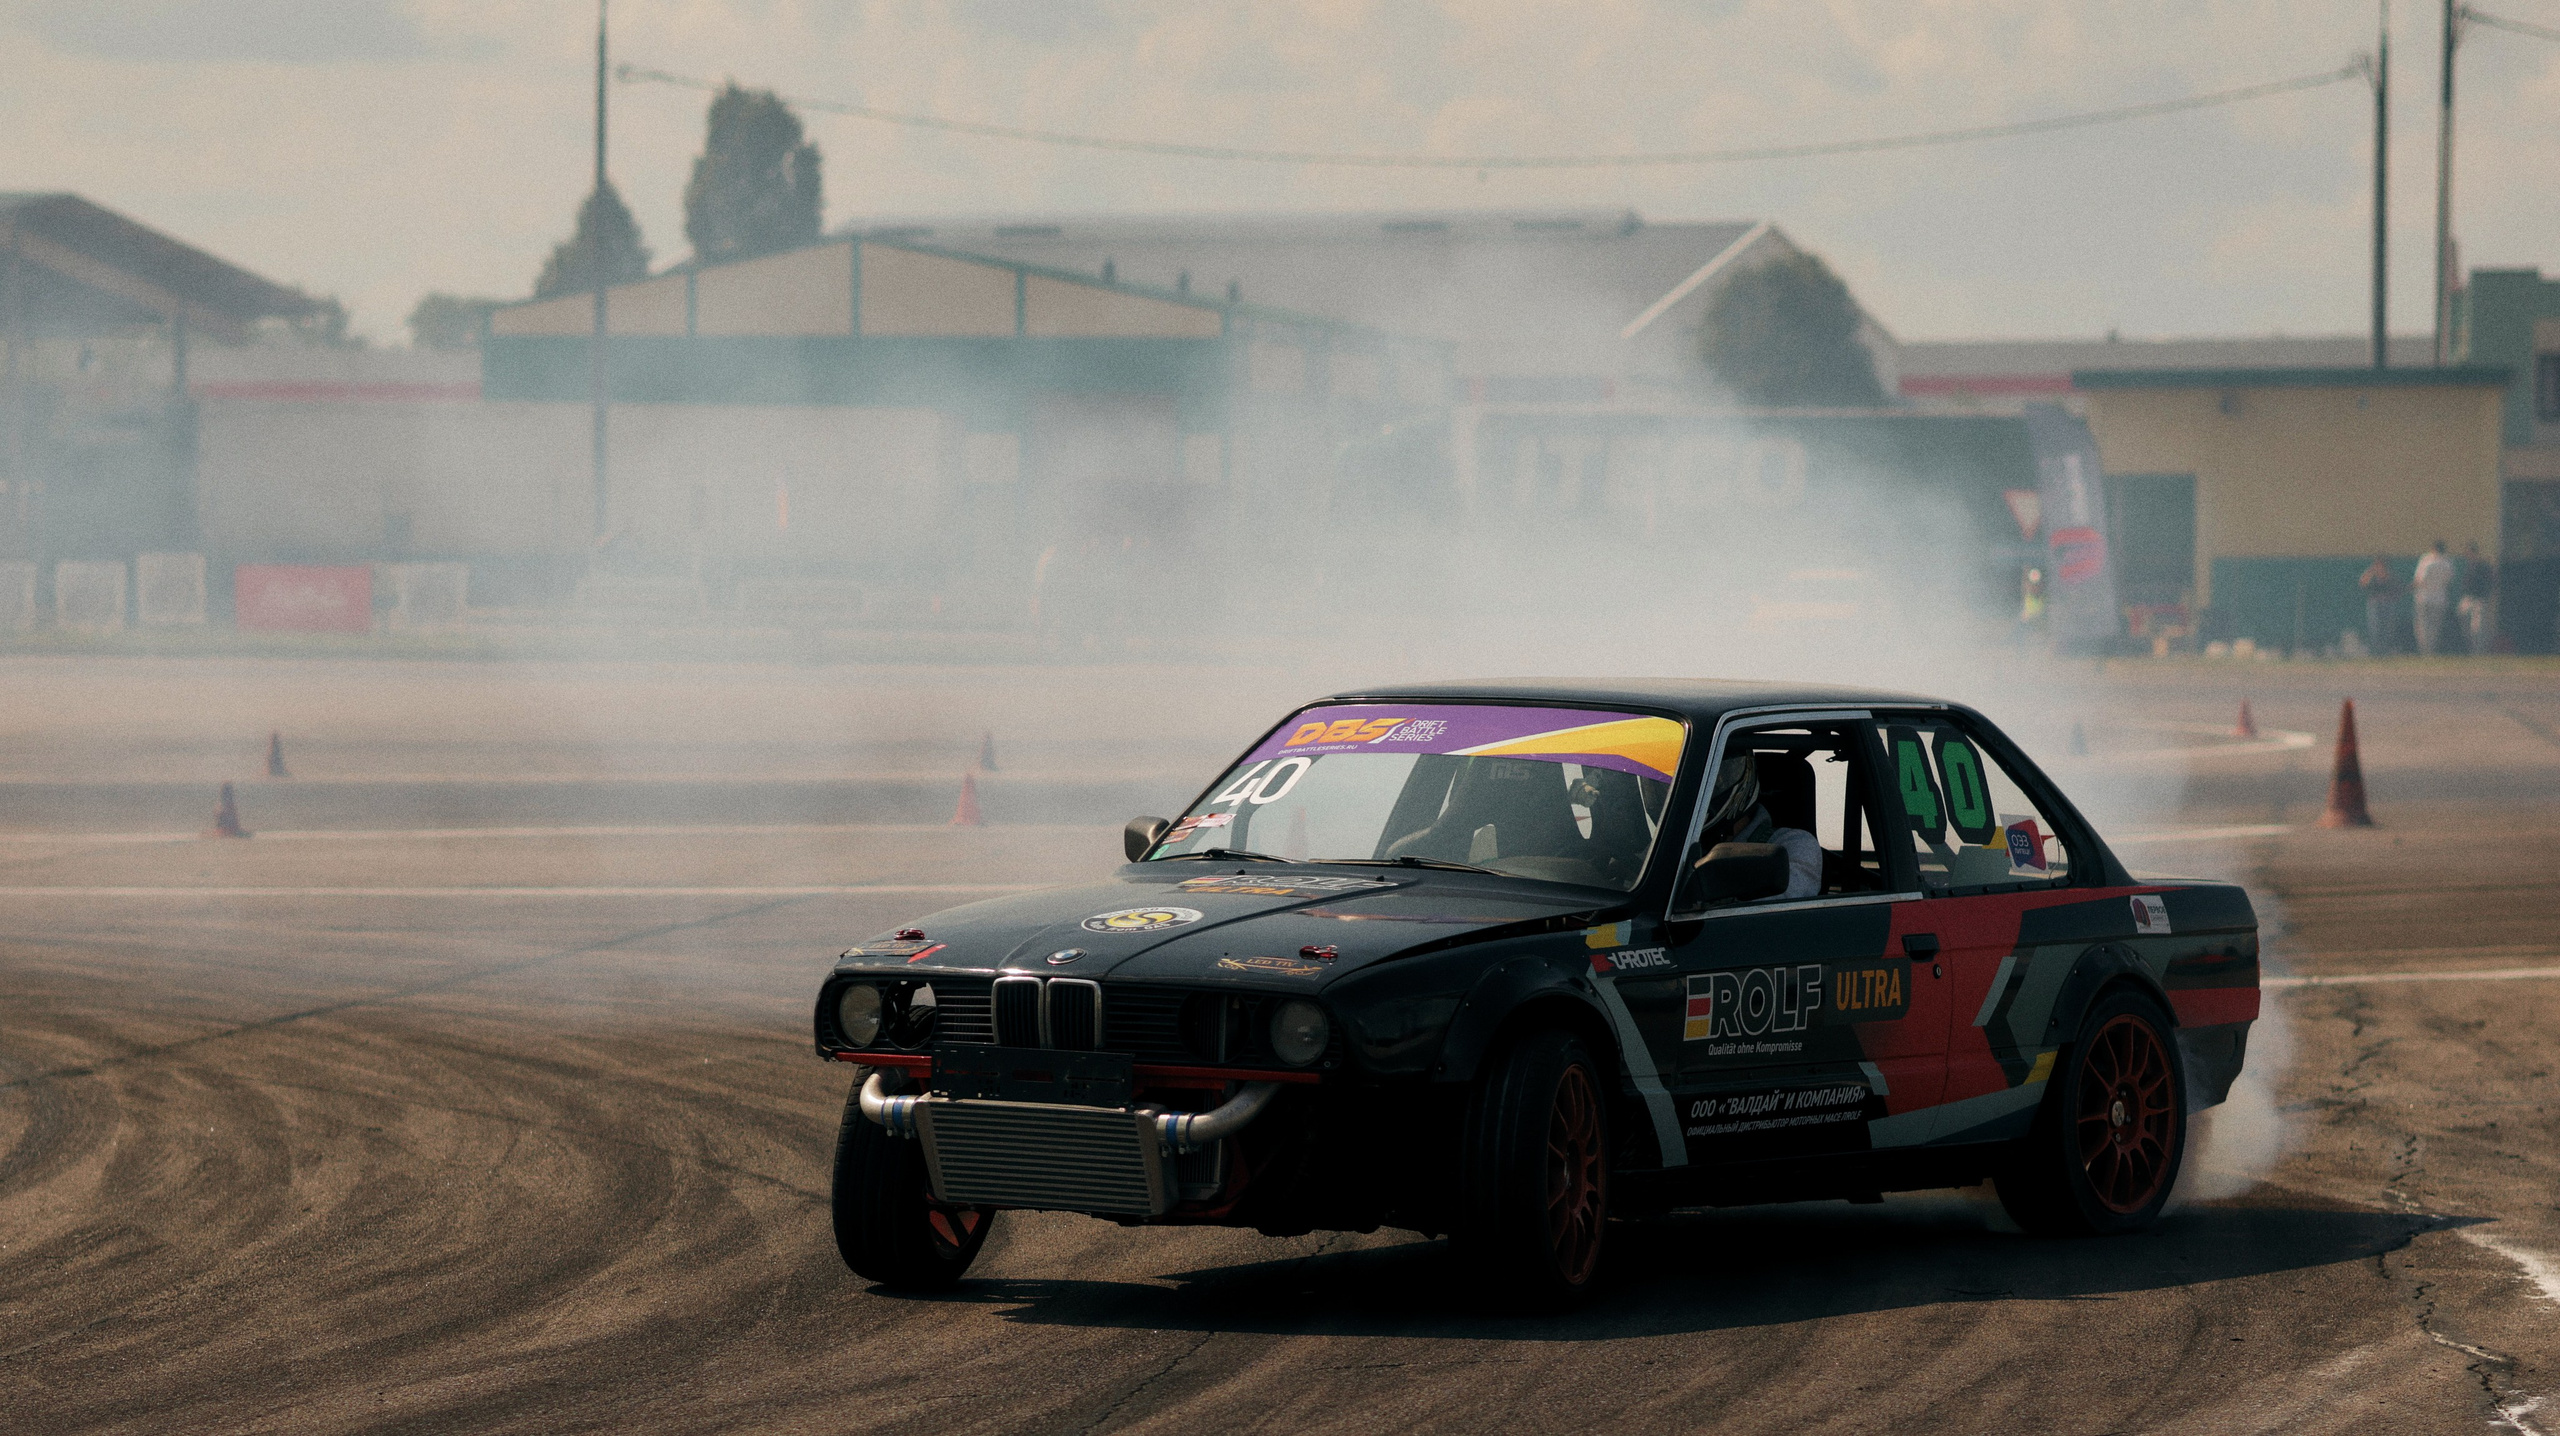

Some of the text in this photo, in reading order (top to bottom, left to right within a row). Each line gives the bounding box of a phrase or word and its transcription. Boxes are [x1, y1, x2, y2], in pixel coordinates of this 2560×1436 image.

[1284, 718, 1407, 747] DBS
[1399, 727, 1448, 735] BATTLE
[1411, 720, 1448, 728] DRIFT
[1277, 745, 1358, 755] DRIFTBATTLESERIES.RU
[1389, 734, 1435, 742] SERIES
[1211, 756, 1312, 807] 40
[1896, 739, 1988, 830] 40
[1709, 964, 1822, 1039] ROLF
[1836, 968, 1902, 1011] ULTRA
[1708, 1040, 1803, 1056] Qualität ohne Kompromisse
[1691, 1099, 1717, 1118] ООО
[1795, 1085, 1866, 1109] КОМПАНИЯ»
[1687, 1121, 1739, 1136] ОФИЦИАЛЬНЫЙ
[1737, 1116, 1789, 1133] ДИСТРИБЬЮТОР
[1788, 1114, 1824, 1127] МОТОРНЫХ
